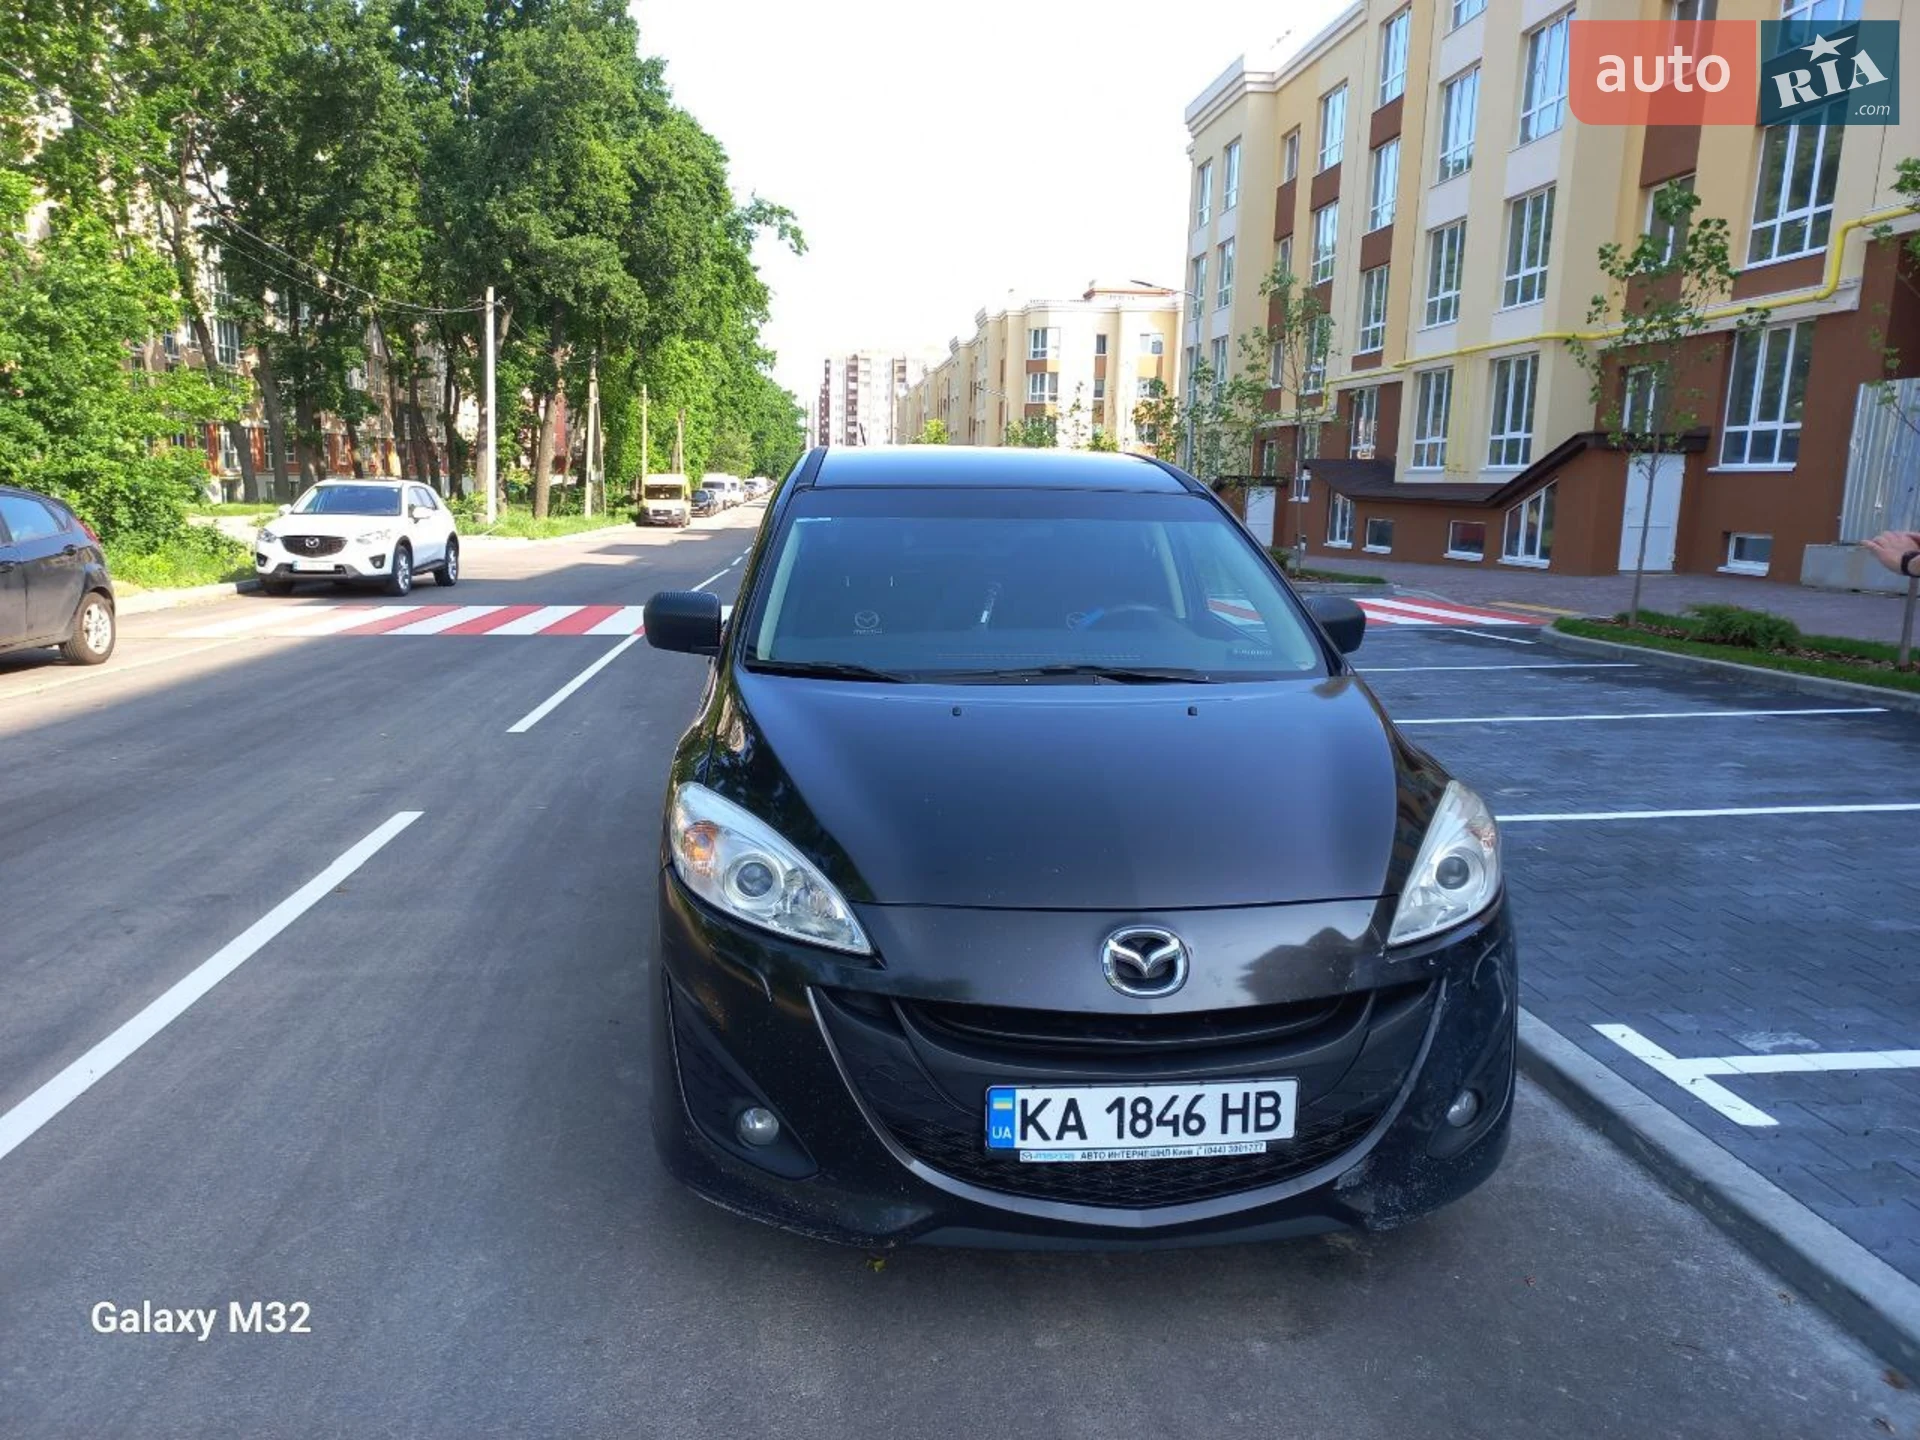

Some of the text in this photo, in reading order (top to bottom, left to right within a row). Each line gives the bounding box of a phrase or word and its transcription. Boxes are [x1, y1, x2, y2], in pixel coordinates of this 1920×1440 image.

[1020, 1090, 1282, 1141] KA 1846 HB
[992, 1126, 1012, 1140] UA
[1080, 1151, 1106, 1160] АВТО
